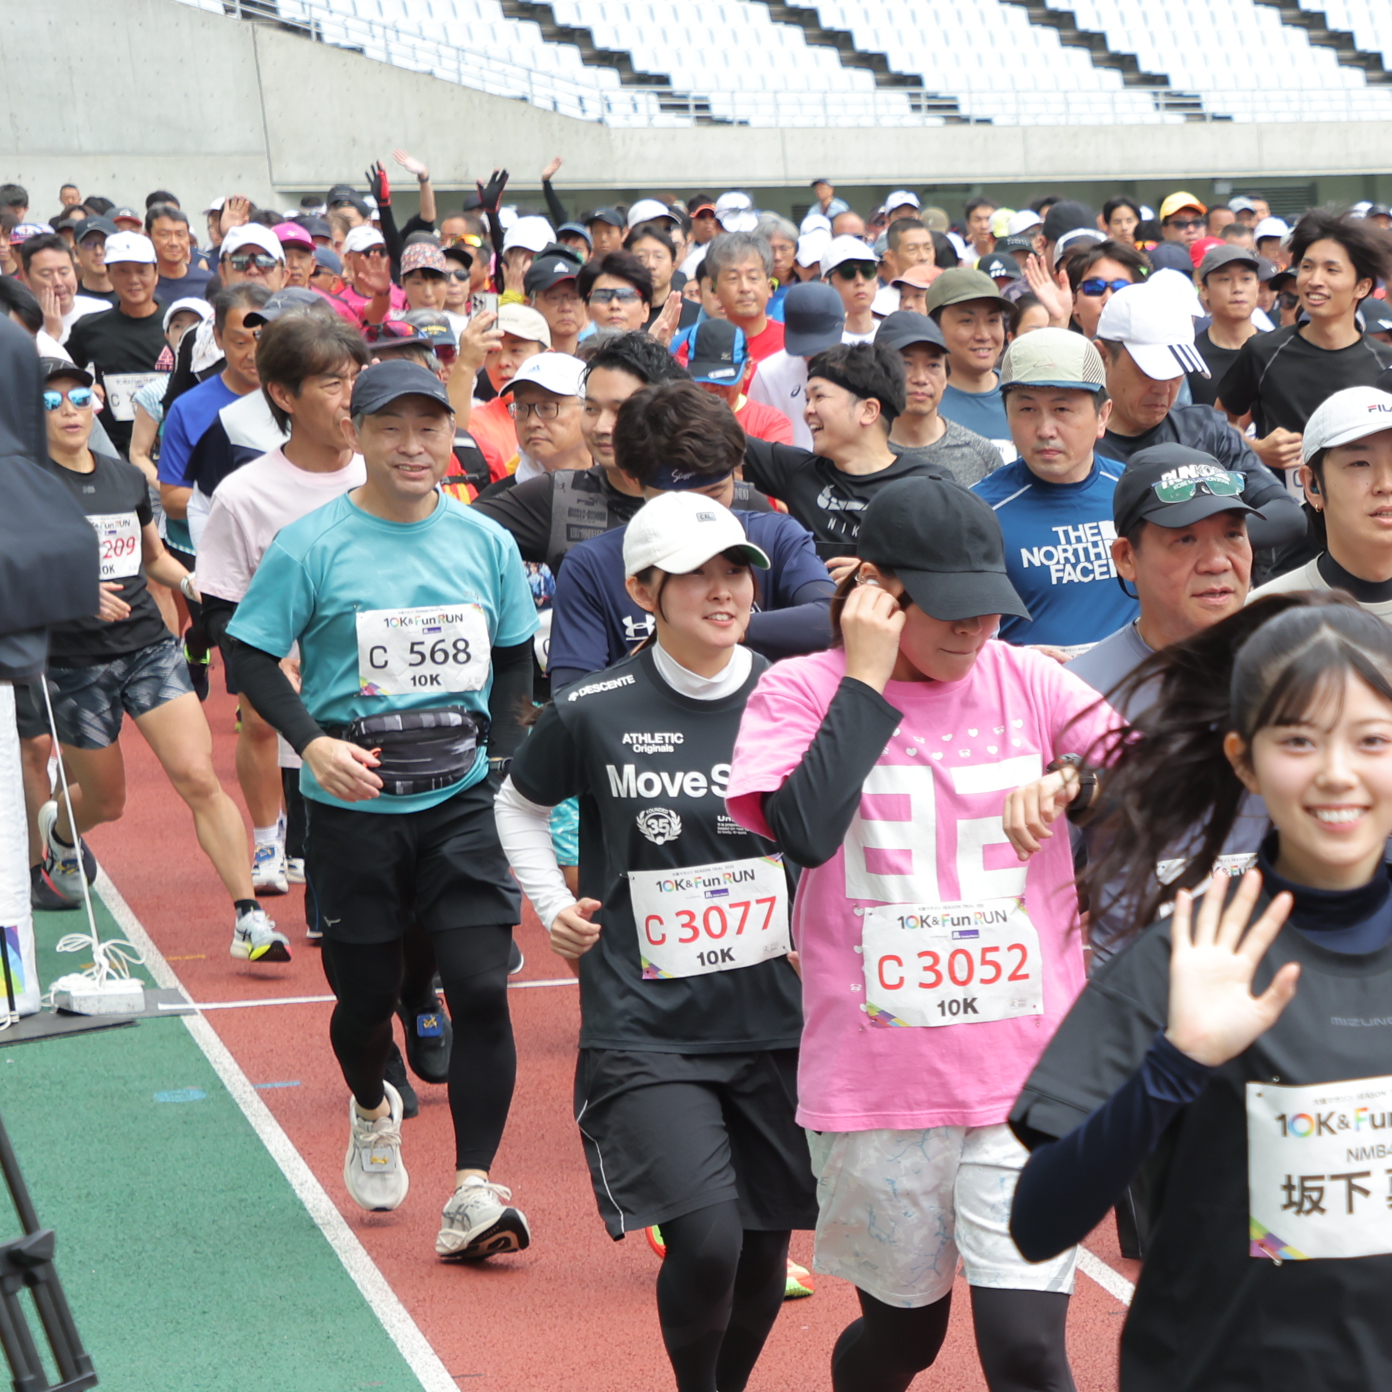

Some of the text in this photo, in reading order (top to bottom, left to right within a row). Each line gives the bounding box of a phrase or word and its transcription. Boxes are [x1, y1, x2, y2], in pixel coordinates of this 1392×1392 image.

[1052, 523, 1102, 545] THE
[438, 613, 463, 625] RUN
[369, 638, 472, 669] C 568
[410, 673, 442, 687] 10K
[578, 674, 636, 697] DESCENTE
[622, 733, 684, 745] ATHLETIC
[633, 744, 675, 755] Originals
[647, 818, 670, 835] 35
[723, 868, 755, 884] RUN
[645, 895, 777, 946] C 3077
[974, 910, 1008, 925] RUN
[697, 946, 735, 967] 10K
[878, 943, 1030, 990] C 3052
[937, 997, 979, 1017] 10K
[1356, 1091, 1388, 1102] SEASON
[1280, 1170, 1372, 1218] 坂下
